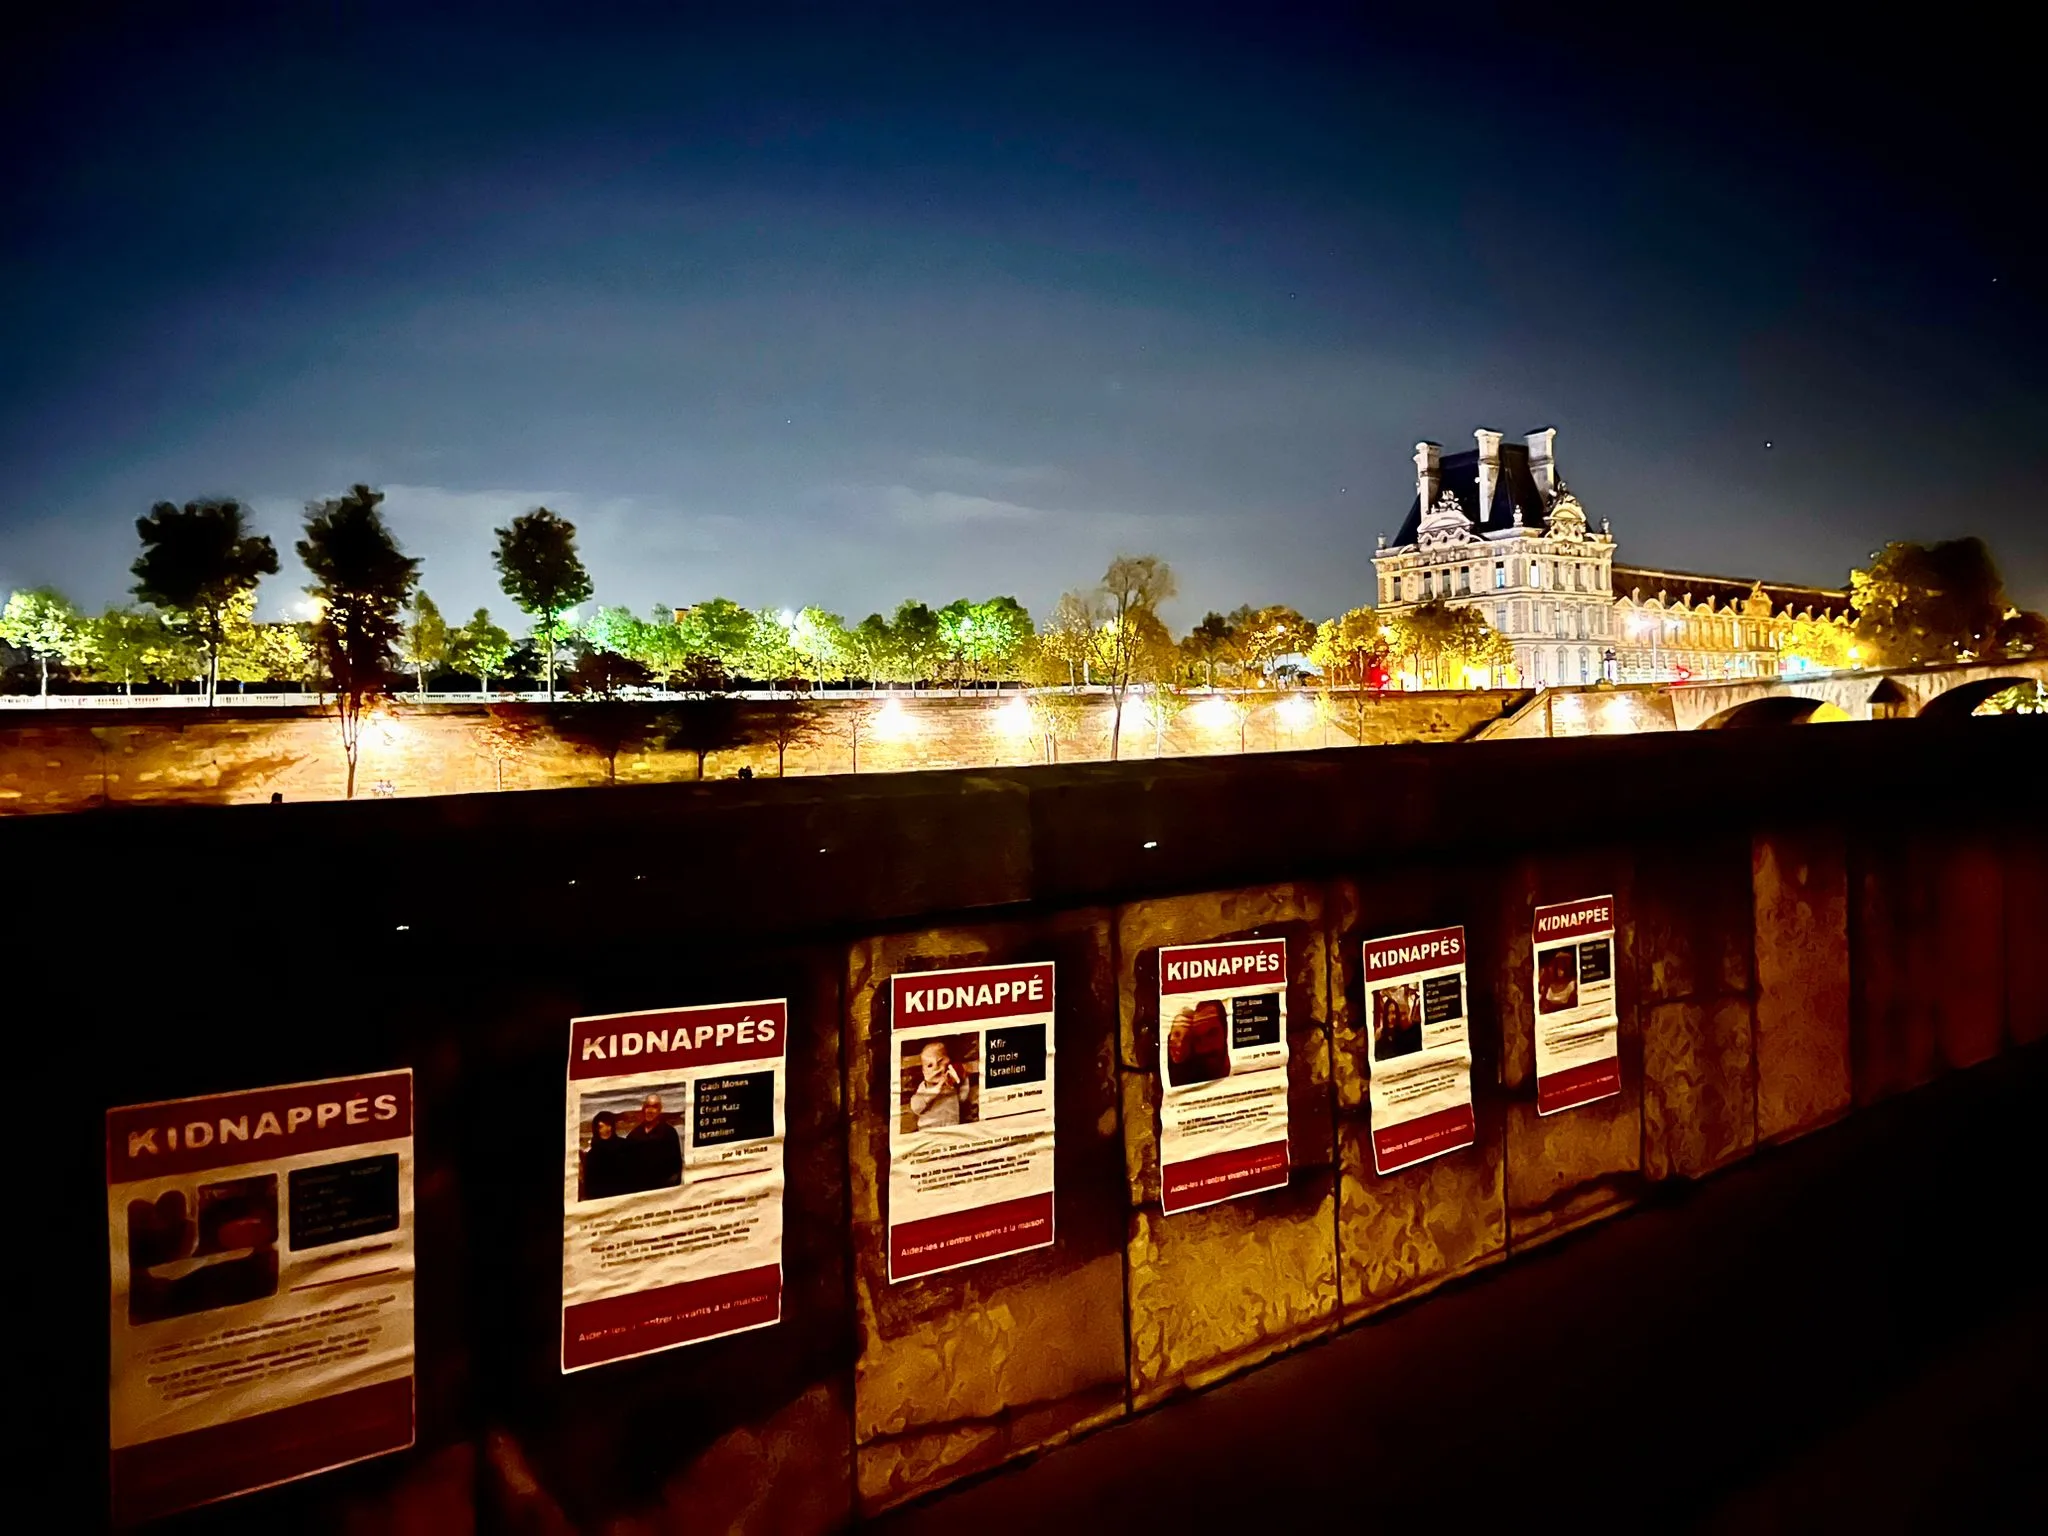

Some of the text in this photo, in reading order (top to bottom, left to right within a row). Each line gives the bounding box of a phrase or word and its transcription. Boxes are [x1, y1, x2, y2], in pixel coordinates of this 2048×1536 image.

[1167, 950, 1280, 981] KIDNAPPÉS
[1369, 936, 1460, 970] KIDNAPPÉS
[905, 974, 1044, 1014] KIDNAPPÉ
[581, 1016, 776, 1061] KIDNAPPÉS
[990, 1038, 1006, 1049] Kfir
[990, 1052, 1018, 1063] 9 mois
[722, 1080, 749, 1089] Moses
[128, 1093, 398, 1158] KIDNAPPÉS
